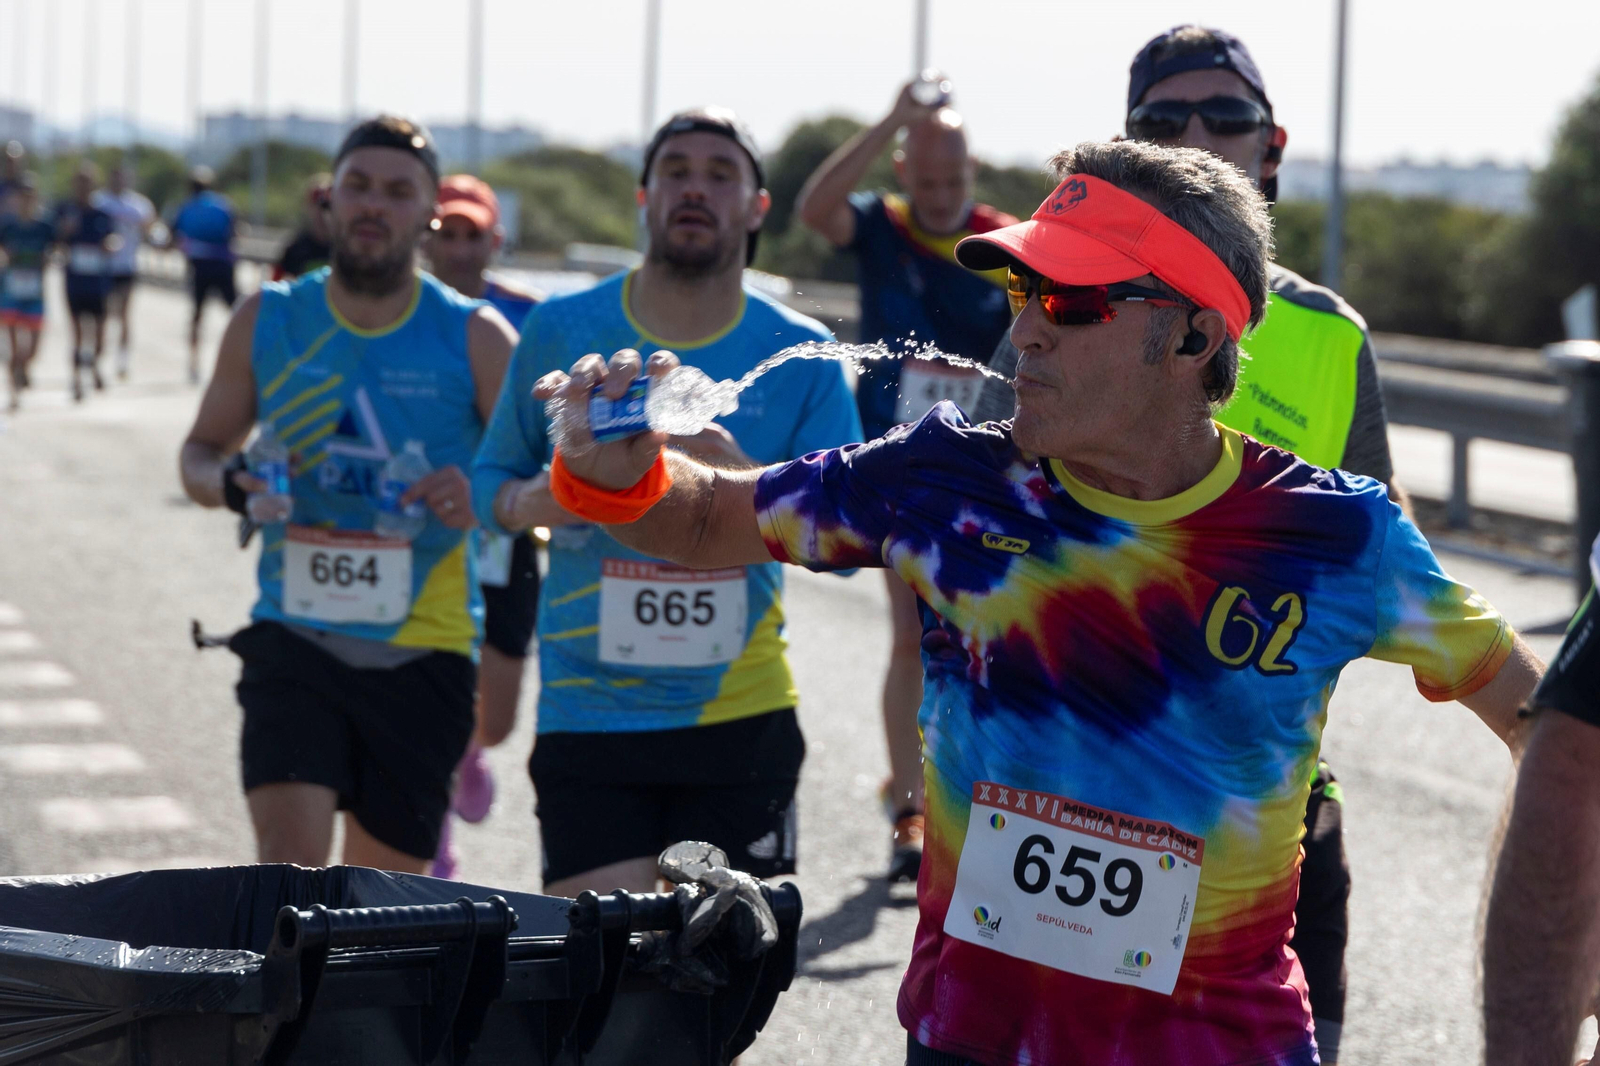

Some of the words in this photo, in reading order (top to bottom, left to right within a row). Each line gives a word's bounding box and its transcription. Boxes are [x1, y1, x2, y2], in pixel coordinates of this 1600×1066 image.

[310, 552, 380, 589] 664
[634, 587, 716, 627] 665
[1203, 584, 1305, 673] 62
[978, 783, 1060, 820] XXXVI
[1062, 802, 1115, 825] MEDIA
[1060, 812, 1114, 837] BAHÍA
[1119, 828, 1142, 843] DE
[1146, 834, 1197, 859] CÁDIZ
[1013, 833, 1144, 917] 659
[1036, 912, 1093, 936] SEPÚLVEDA
